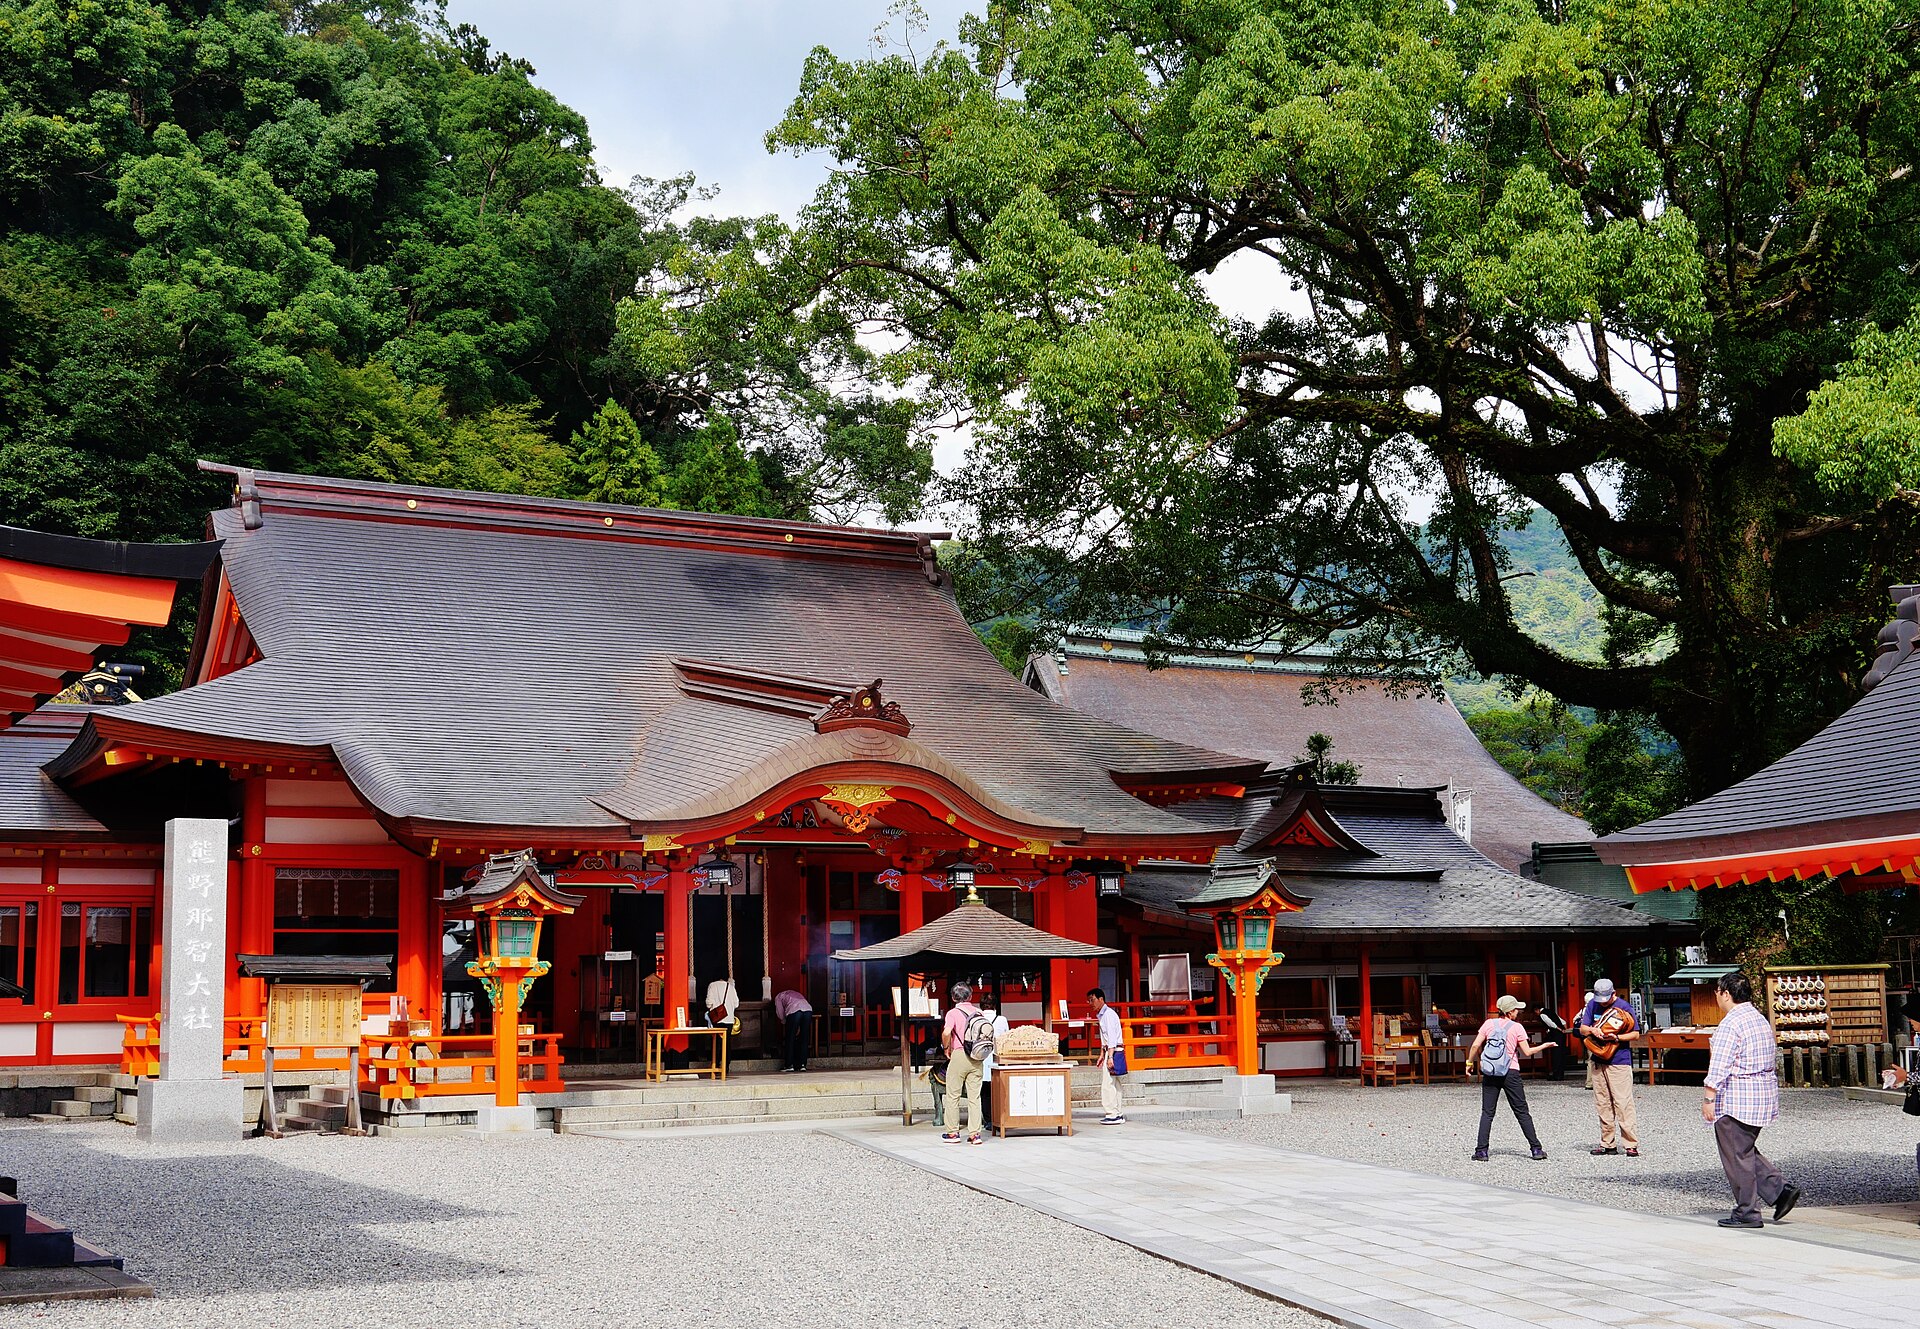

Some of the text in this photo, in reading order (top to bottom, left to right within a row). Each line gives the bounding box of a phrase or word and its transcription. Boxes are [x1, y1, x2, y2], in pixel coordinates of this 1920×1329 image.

[183, 840, 215, 1030] 熊野那智大社
